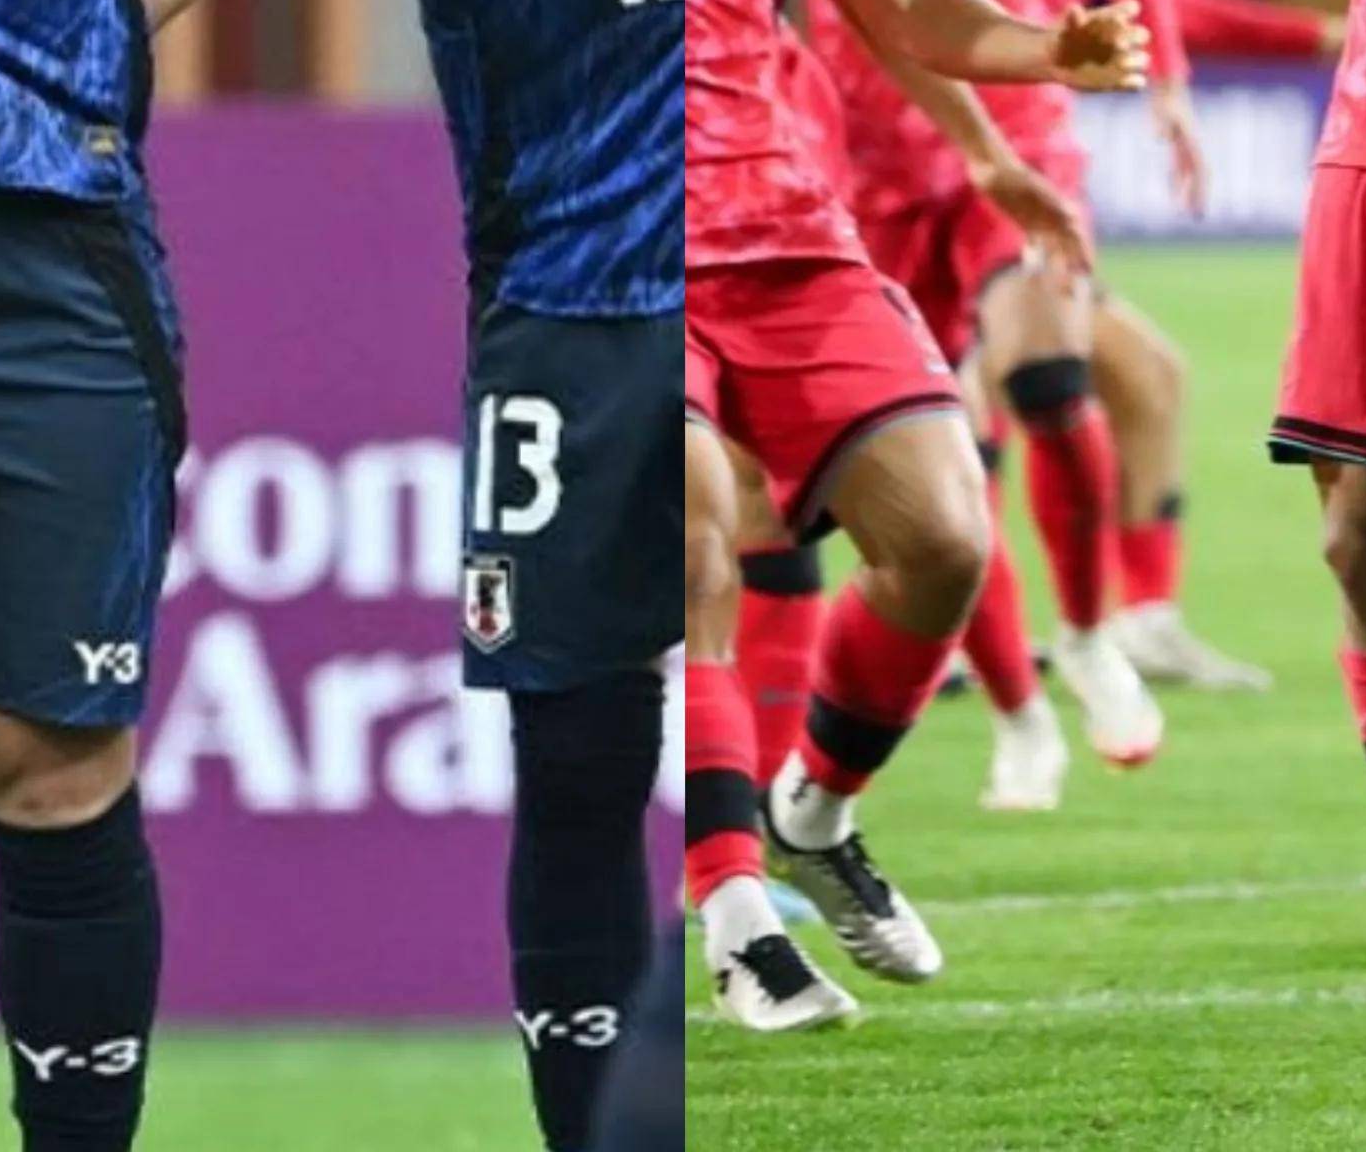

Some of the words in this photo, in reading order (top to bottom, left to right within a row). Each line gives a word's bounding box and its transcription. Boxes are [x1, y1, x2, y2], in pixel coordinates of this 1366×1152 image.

[472, 393, 563, 535] 13
[73, 640, 140, 685] Y-3
[514, 1006, 619, 1049] Y-3
[15, 1036, 140, 1082] Y-3
